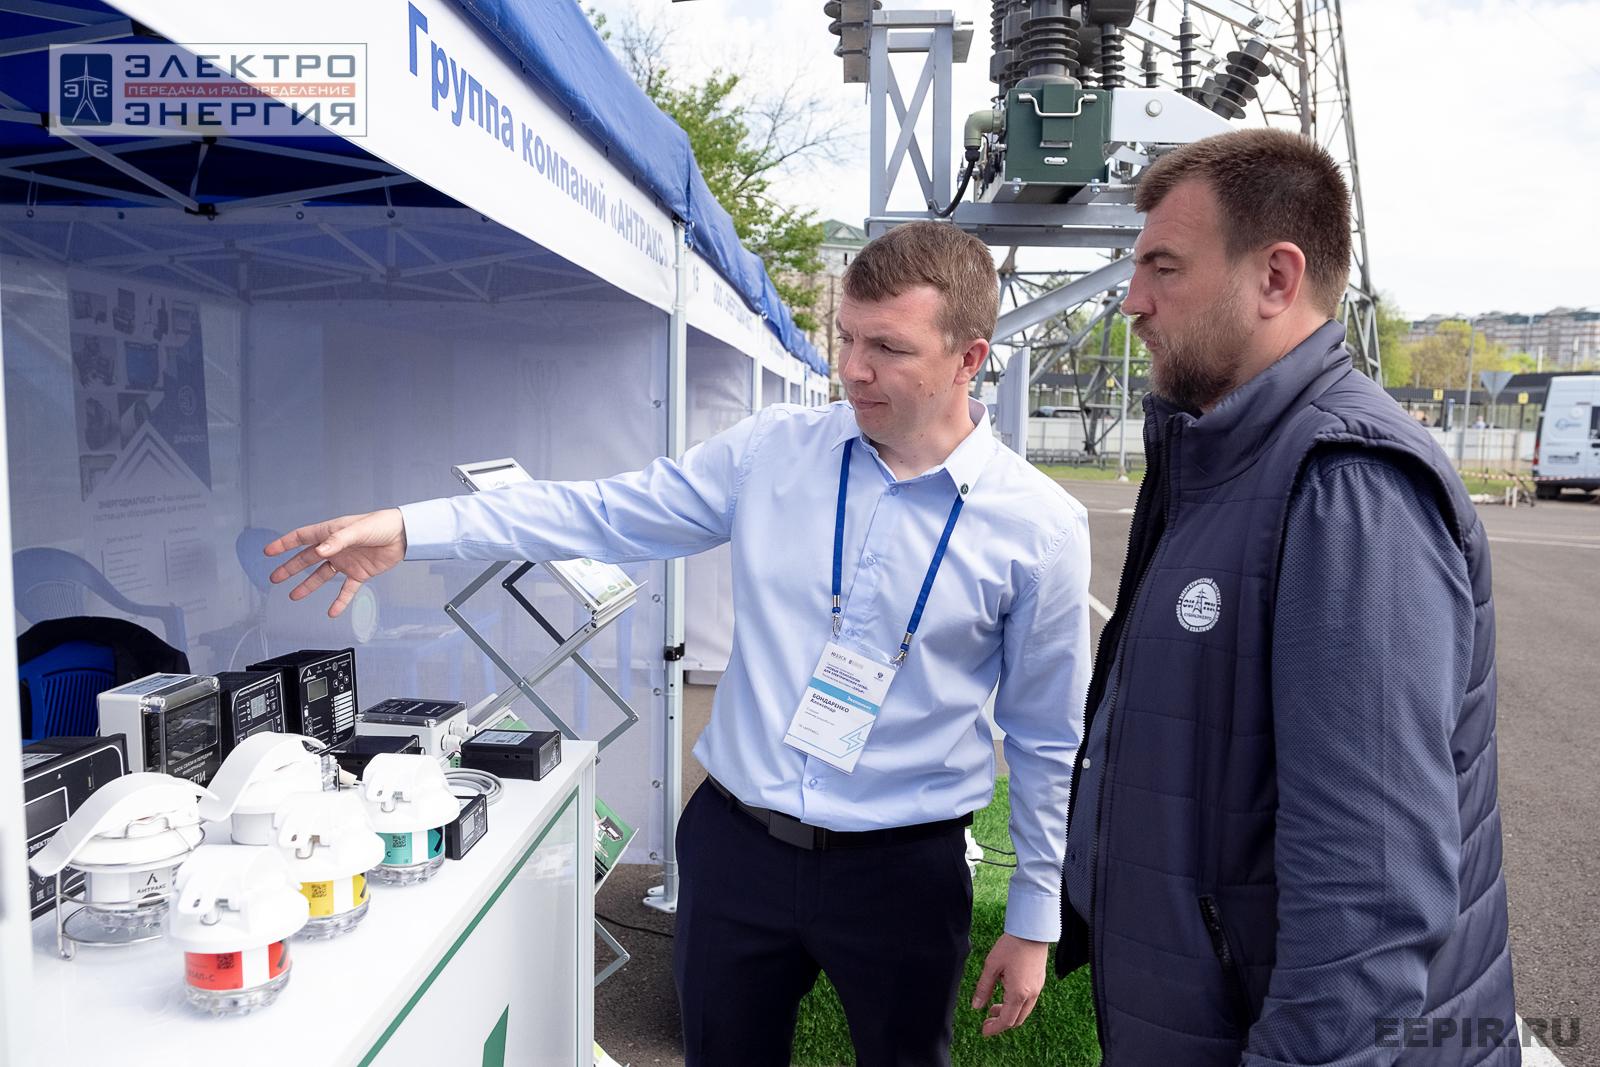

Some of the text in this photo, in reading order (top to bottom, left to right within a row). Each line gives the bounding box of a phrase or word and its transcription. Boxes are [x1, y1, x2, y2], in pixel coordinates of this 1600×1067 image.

[408, 1, 514, 152] Группа
[521, 122, 606, 223] компаний
[812, 693, 850, 713] БОНДАРЕНКО
